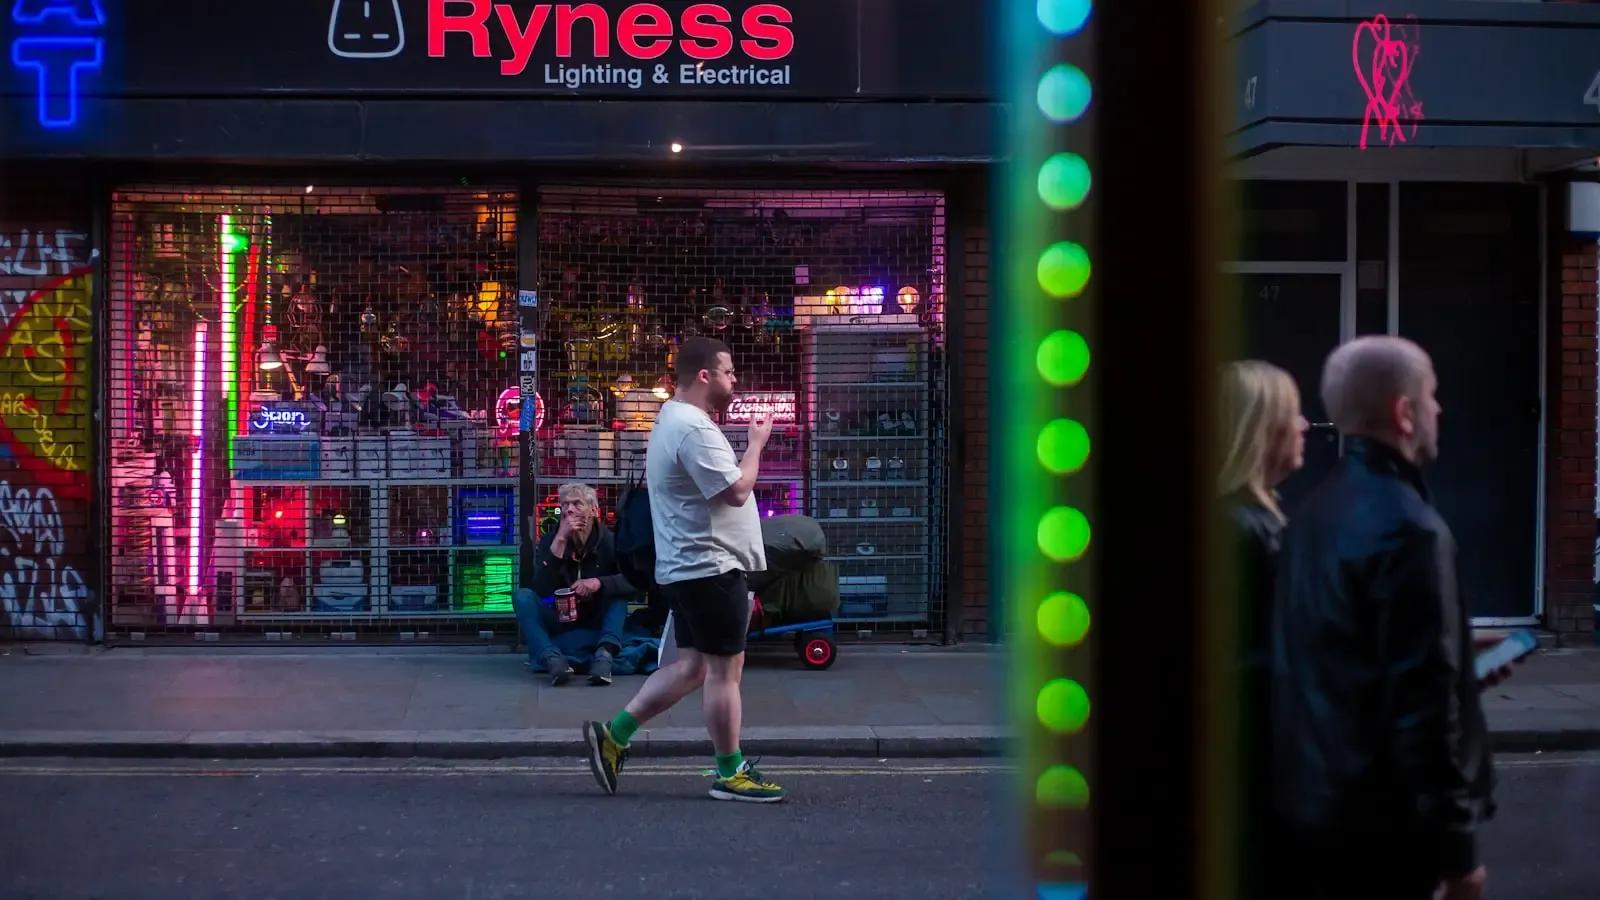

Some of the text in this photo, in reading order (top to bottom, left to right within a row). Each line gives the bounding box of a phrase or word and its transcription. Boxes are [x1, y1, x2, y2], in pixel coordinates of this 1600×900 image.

[427, 0, 795, 75] Ryness
[544, 64, 791, 88] Lighting & Electrical
[1244, 75, 1258, 109] 47
[1258, 284, 1279, 303] 47
